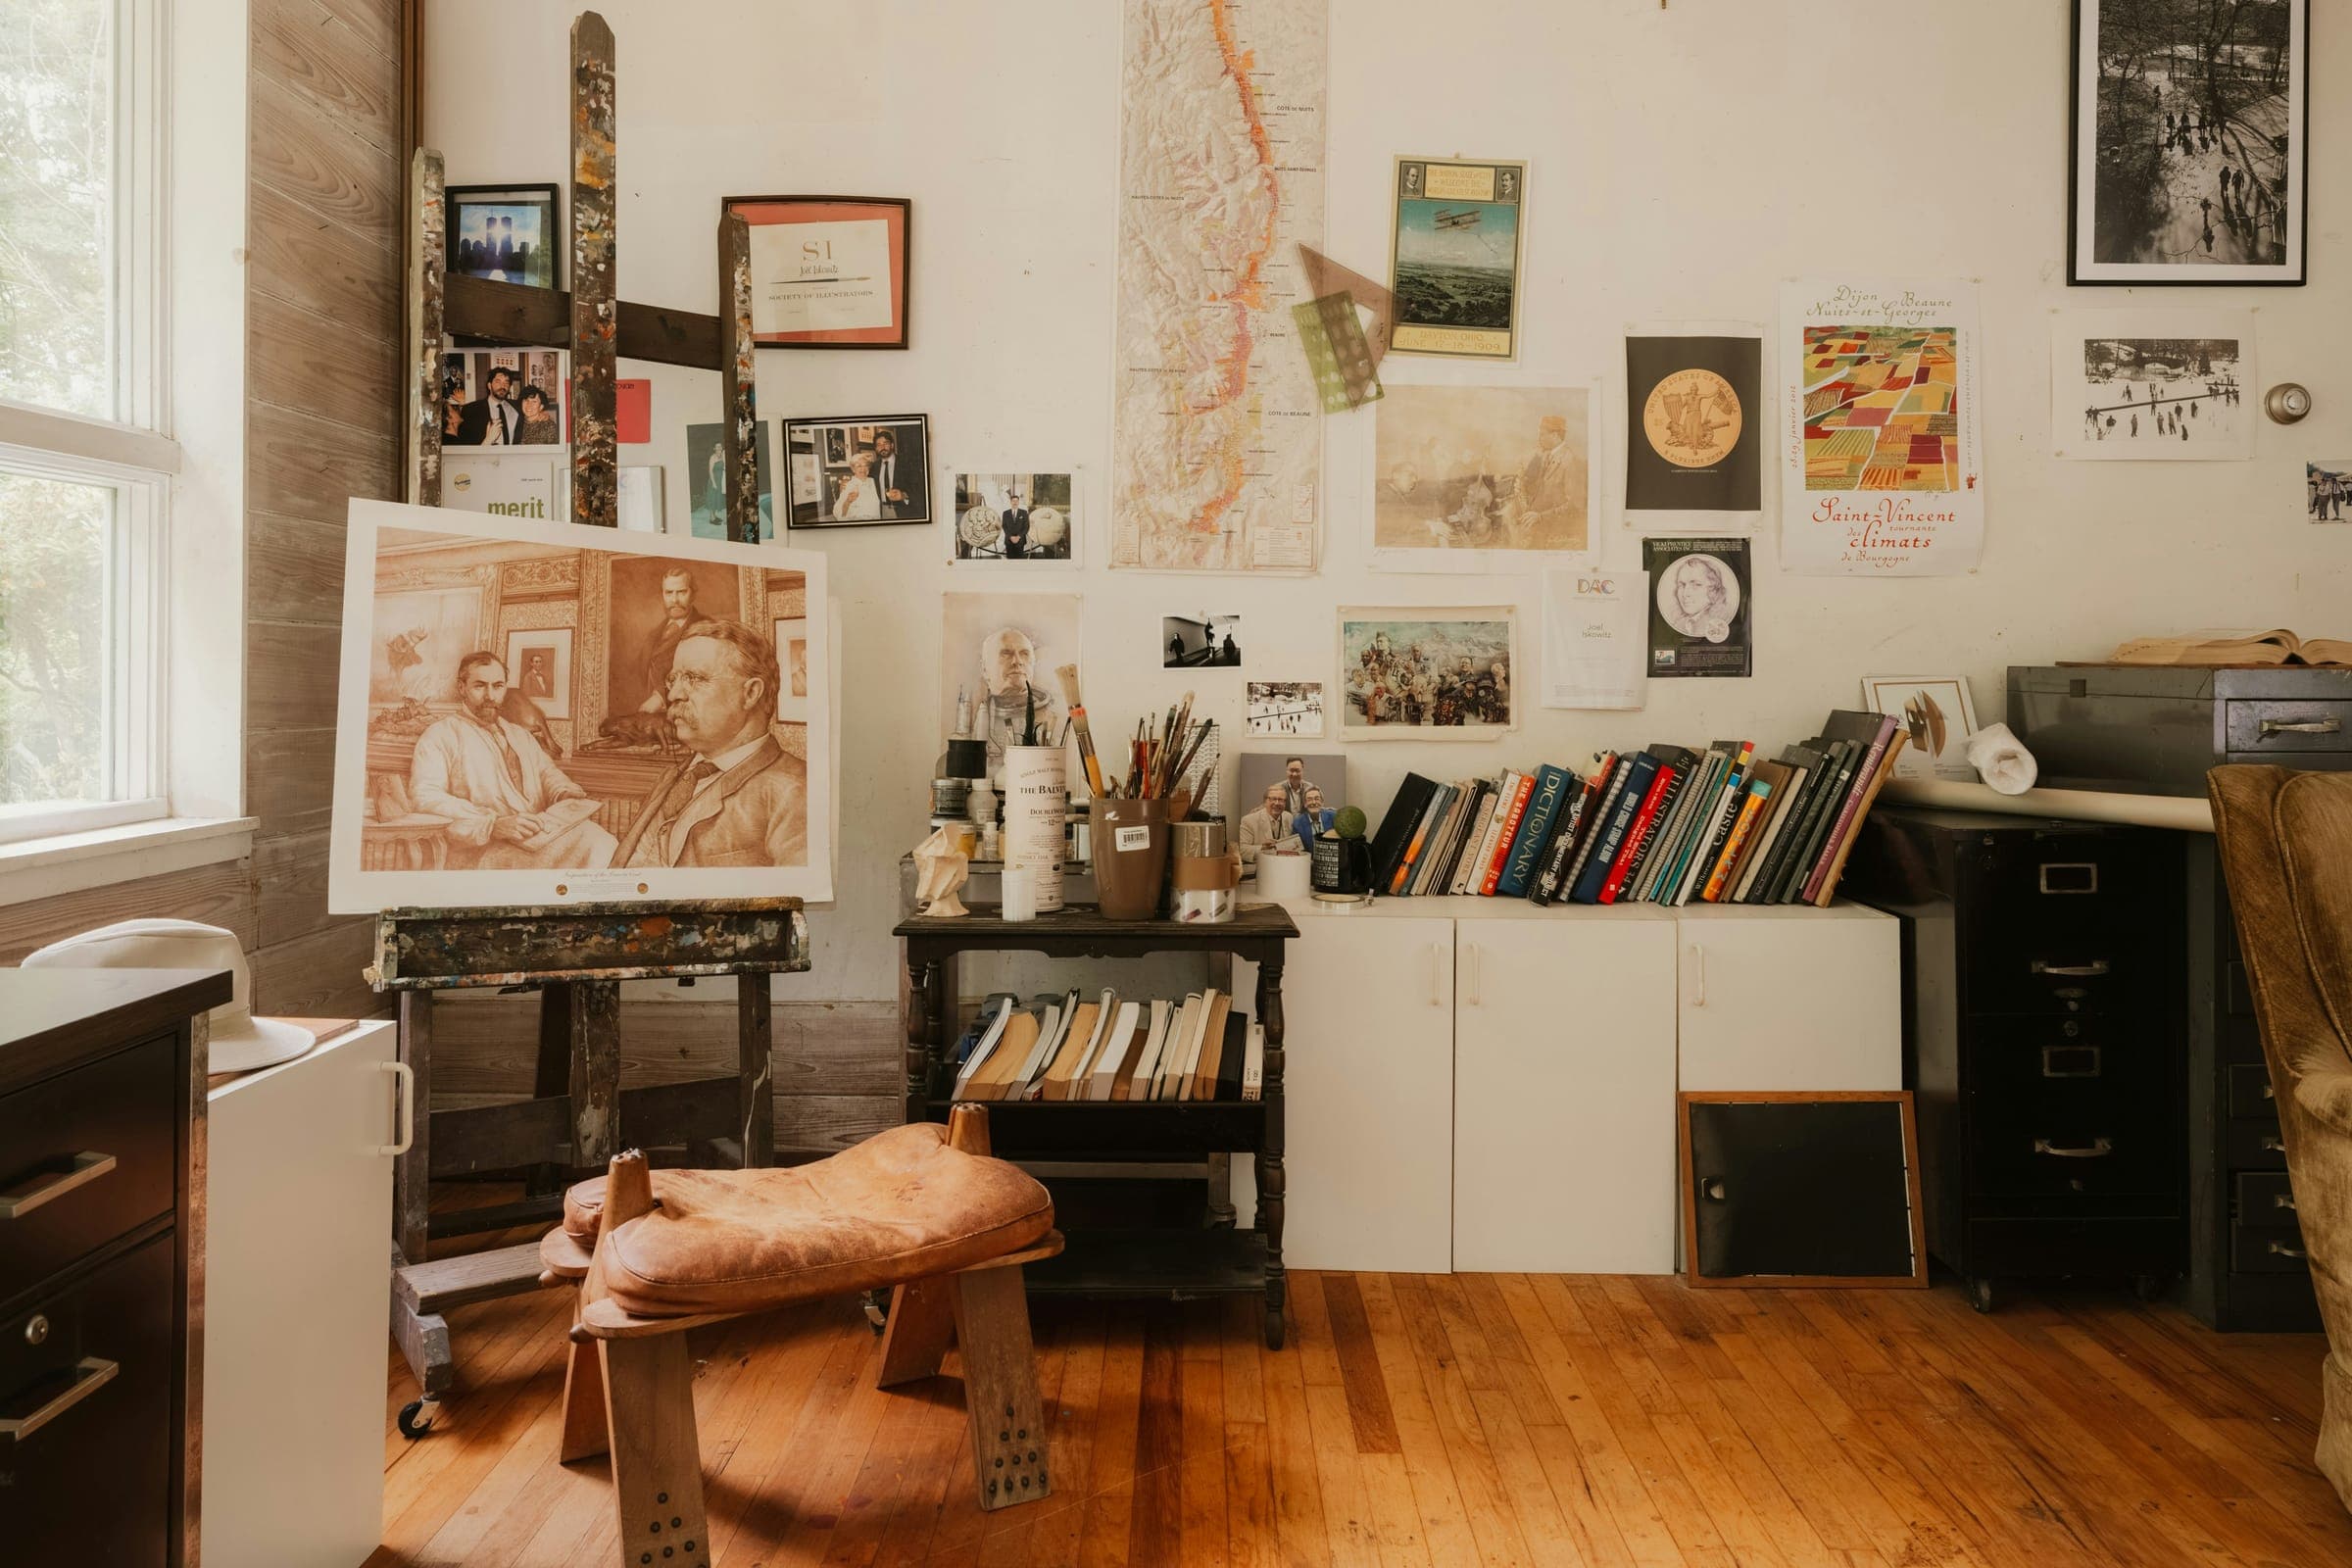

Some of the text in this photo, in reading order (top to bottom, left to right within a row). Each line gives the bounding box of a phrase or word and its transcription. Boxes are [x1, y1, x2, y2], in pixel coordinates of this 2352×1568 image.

[815, 290, 873, 300] ILLUSTRATORS
[1834, 284, 1953, 308] Dijon Beaune
[1806, 301, 1937, 325] Nuits-st-Georges
[1460, 332, 1484, 342] OHIO
[1648, 385, 1668, 414] UNITED
[1669, 373, 1700, 386] STATES
[1716, 380, 1740, 416] AMERICA
[1670, 453, 1704, 464] PLURIBUS
[488, 496, 544, 518] merit
[1812, 497, 1956, 523] Saint-Vincent
[1847, 527, 1861, 537] des
[1850, 519, 1932, 549] climats
[1840, 550, 1910, 568] de Bourgogne
[1577, 578, 1615, 595] DAC
[1582, 630, 1613, 639] Iskowitz
[1587, 622, 1603, 631] Joel
[1849, 740, 1885, 798] Rembrandt
[1499, 780, 1530, 849] THE SABOTEUR
[1566, 811, 1579, 832] ARTIST
[1629, 771, 1683, 869] ILLUSTRATORS
[1509, 773, 1561, 883] DICTIONARY
[1549, 830, 1572, 873] DOCUMENTARY
[1540, 870, 1555, 897] PROJECT
